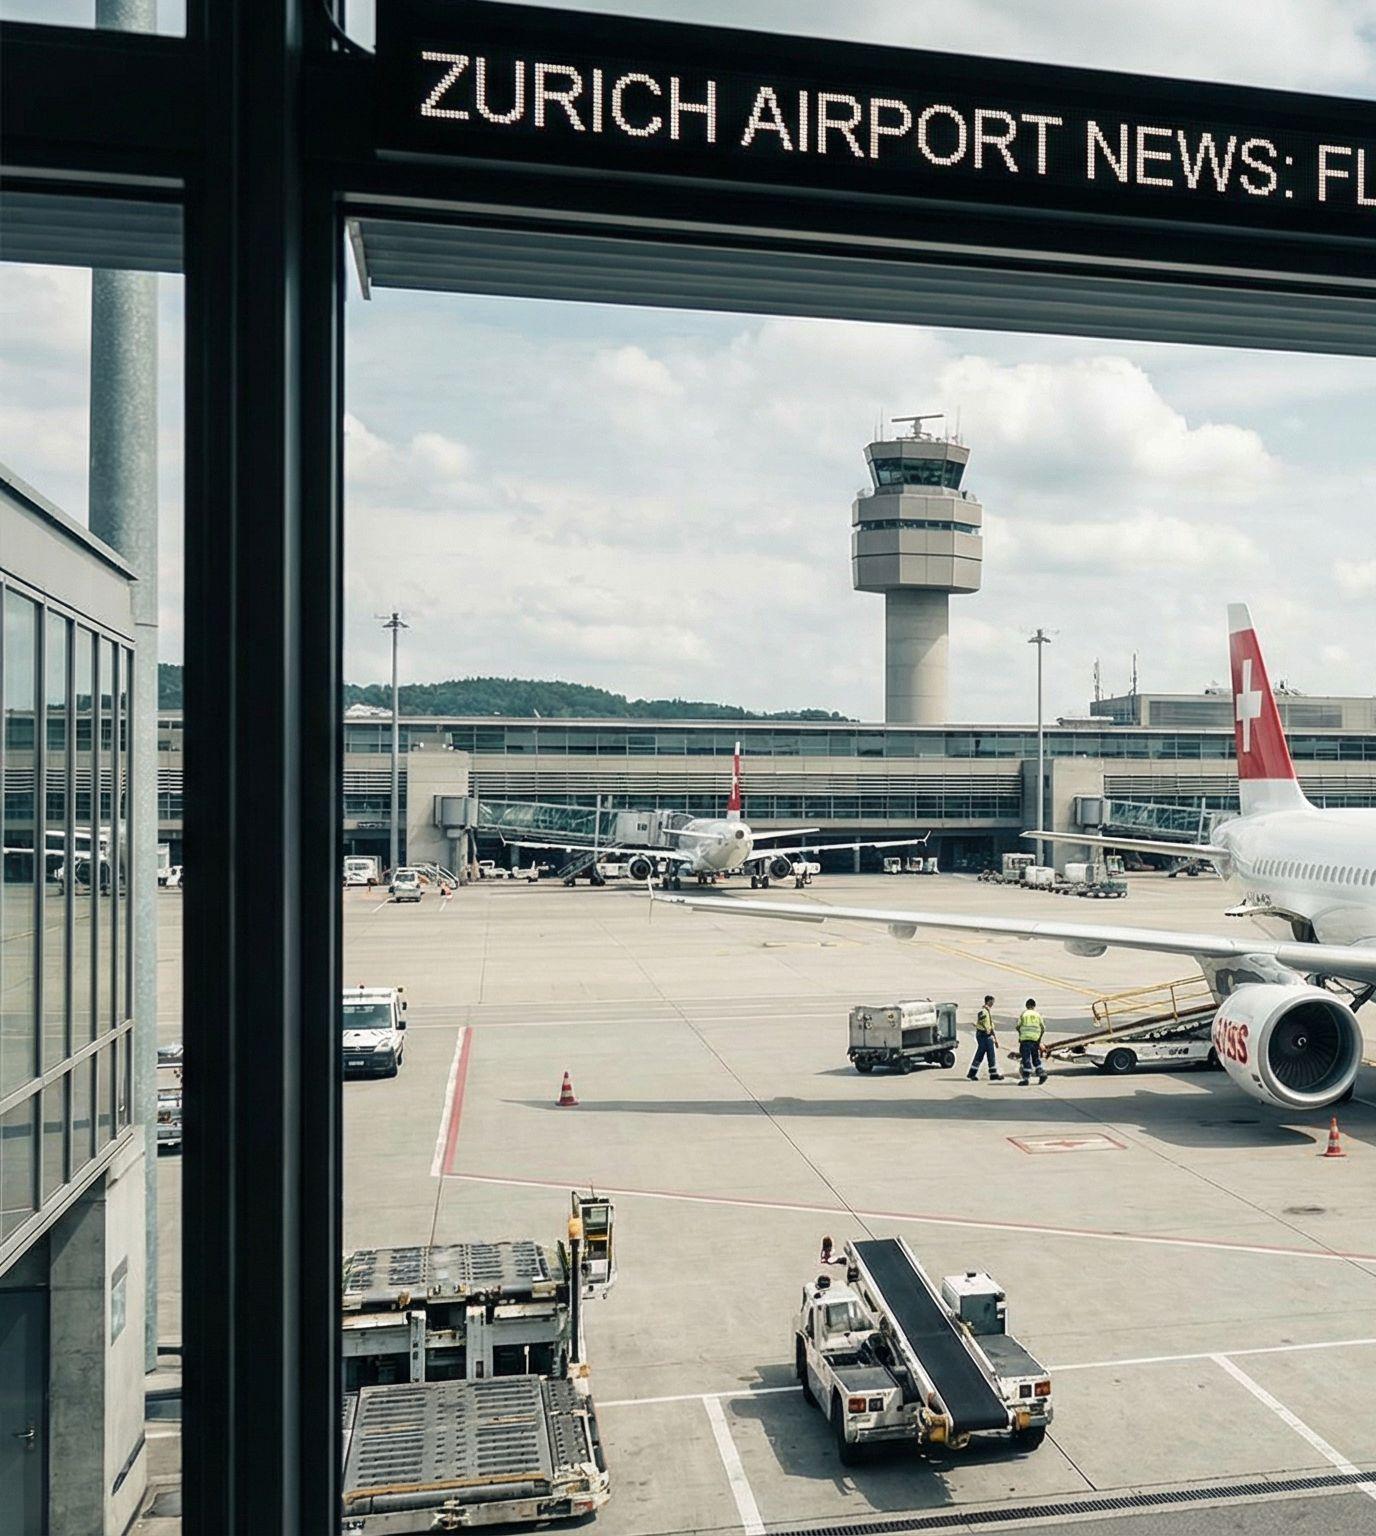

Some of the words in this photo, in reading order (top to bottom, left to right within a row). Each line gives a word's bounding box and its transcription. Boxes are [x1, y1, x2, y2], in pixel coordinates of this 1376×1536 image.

[421, 52, 716, 142] ZURICH
[741, 87, 1062, 174] AIRPORT
[1088, 121, 1293, 198] NEWS:
